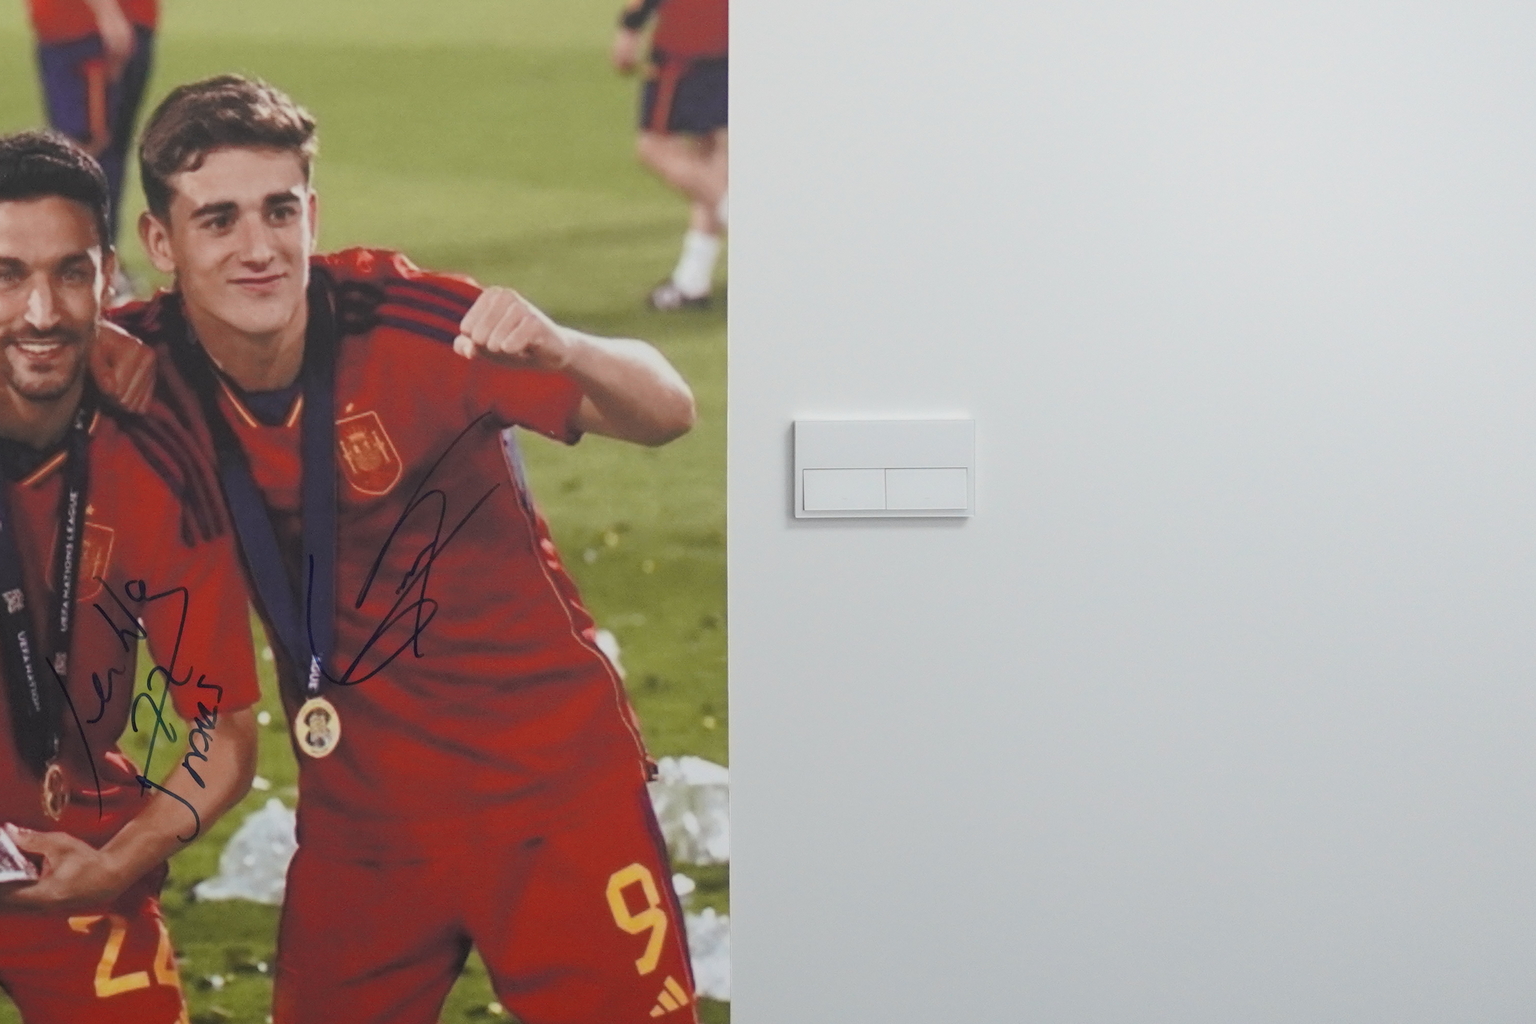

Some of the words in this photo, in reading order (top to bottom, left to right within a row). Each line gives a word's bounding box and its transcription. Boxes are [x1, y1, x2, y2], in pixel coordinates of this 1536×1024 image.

[60, 601, 70, 632] UEFA
[65, 487, 79, 541] LEAGUE
[17, 630, 30, 663] UEFA
[606, 862, 668, 976] 9
